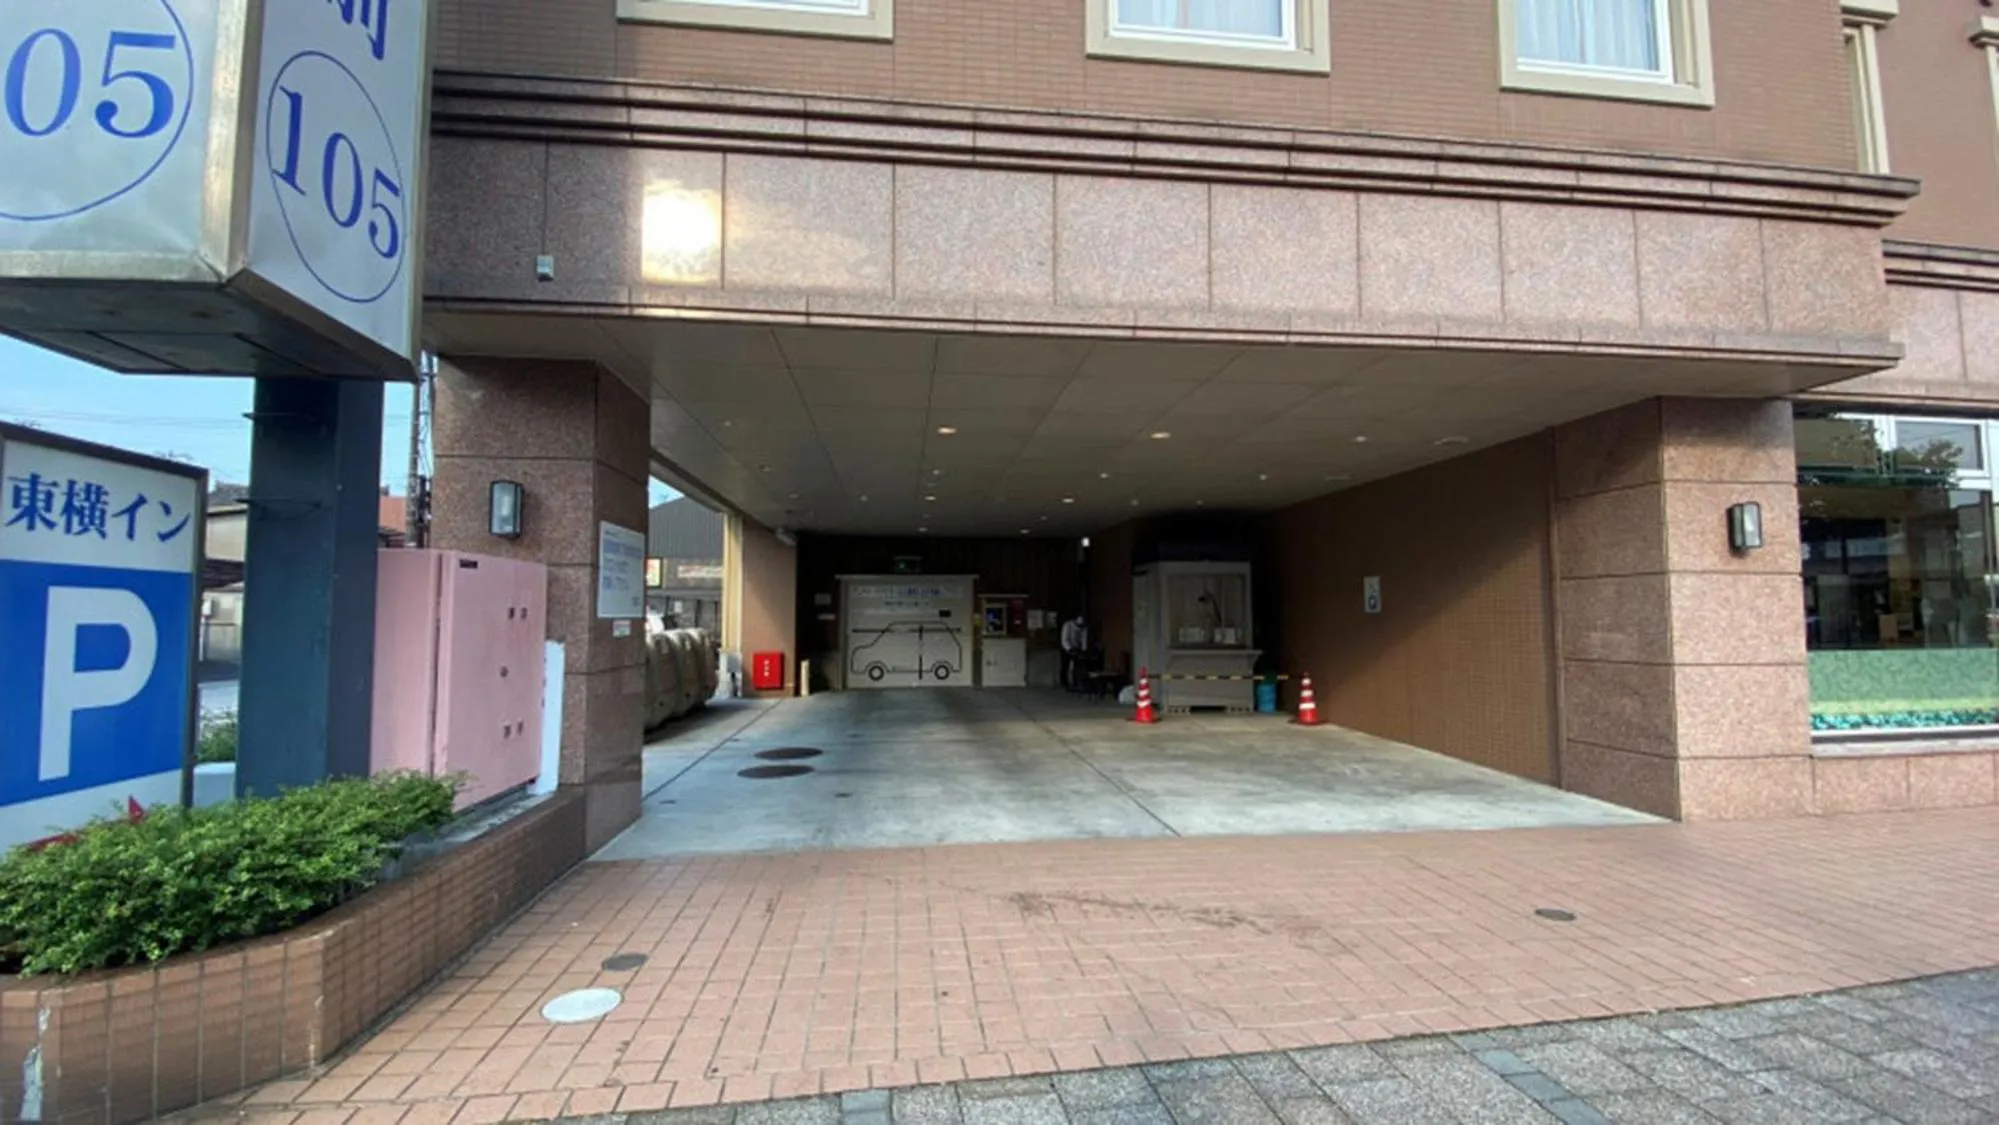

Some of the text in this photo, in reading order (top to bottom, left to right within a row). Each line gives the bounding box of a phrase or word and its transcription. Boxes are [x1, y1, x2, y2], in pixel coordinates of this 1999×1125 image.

[271, 85, 401, 259] 105
[5, 472, 192, 543] 東横イン
[38, 585, 158, 782] P
